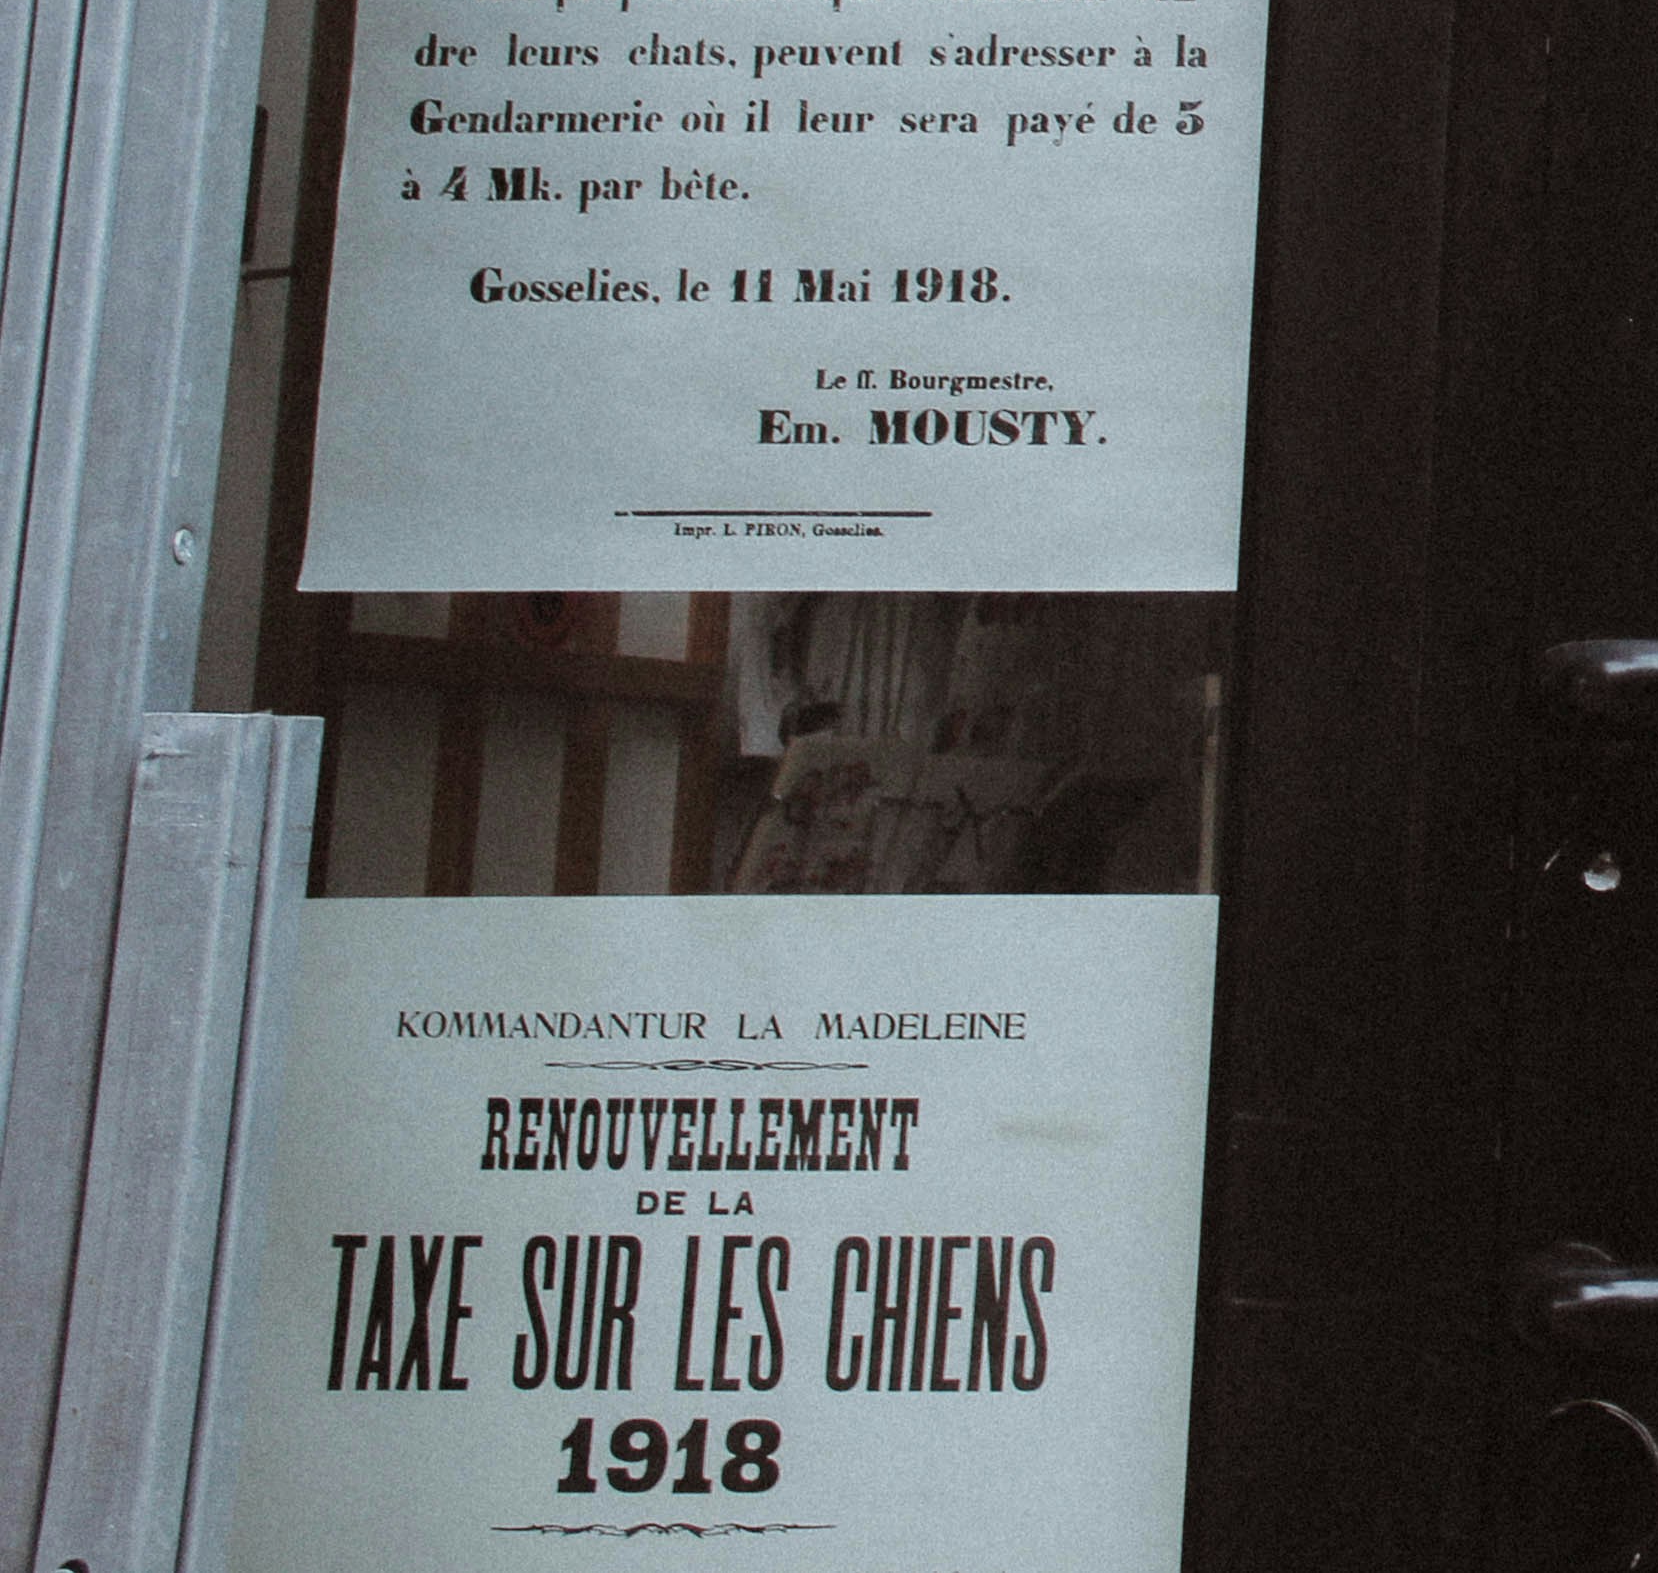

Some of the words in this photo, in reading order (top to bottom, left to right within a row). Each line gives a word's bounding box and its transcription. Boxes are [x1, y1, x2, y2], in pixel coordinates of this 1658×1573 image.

[415, 33, 476, 66] dre
[507, 33, 598, 66] leurs
[628, 33, 736, 73] chats,
[753, 40, 900, 79] peuvent
[930, 33, 1115, 66] s'adresser
[1134, 36, 1152, 67] à
[1176, 34, 1207, 68] la
[409, 99, 662, 135] Gendarmerie
[681, 101, 724, 132] où
[746, 100, 769, 132] il
[799, 100, 874, 132] leur
[900, 113, 977, 133] sera
[1007, 102, 1095, 147] payé
[1113, 101, 1157, 134] de
[401, 168, 420, 200] à
[440, 166, 466, 201] 4
[487, 167, 561, 201] Mk.
[579, 180, 642, 213] par
[661, 166, 749, 200] bête.
[470, 267, 659, 306] Gosselies,
[678, 268, 709, 301] le
[732, 269, 772, 302] 11
[794, 269, 870, 302] Mai
[894, 267, 1010, 303] 1918.
[816, 369, 846, 390] Le
[890, 369, 1053, 396] Bourgmestre,
[759, 410, 839, 444] Em.
[869, 409, 1106, 446] MOUSTY.
[397, 1011, 706, 1039] KOMMANDANTUR
[738, 1014, 782, 1040] LA
[816, 1013, 1025, 1040] MADELEINE
[480, 1097, 919, 1171] RENOUVELLEMENT
[636, 1191, 686, 1215] DE
[708, 1191, 753, 1215] LA
[327, 1234, 483, 1391] TAXE
[512, 1235, 641, 1390] SUR
[674, 1236, 790, 1391] LES
[825, 1236, 1055, 1392] CHIENS
[557, 1418, 781, 1494] 1918
